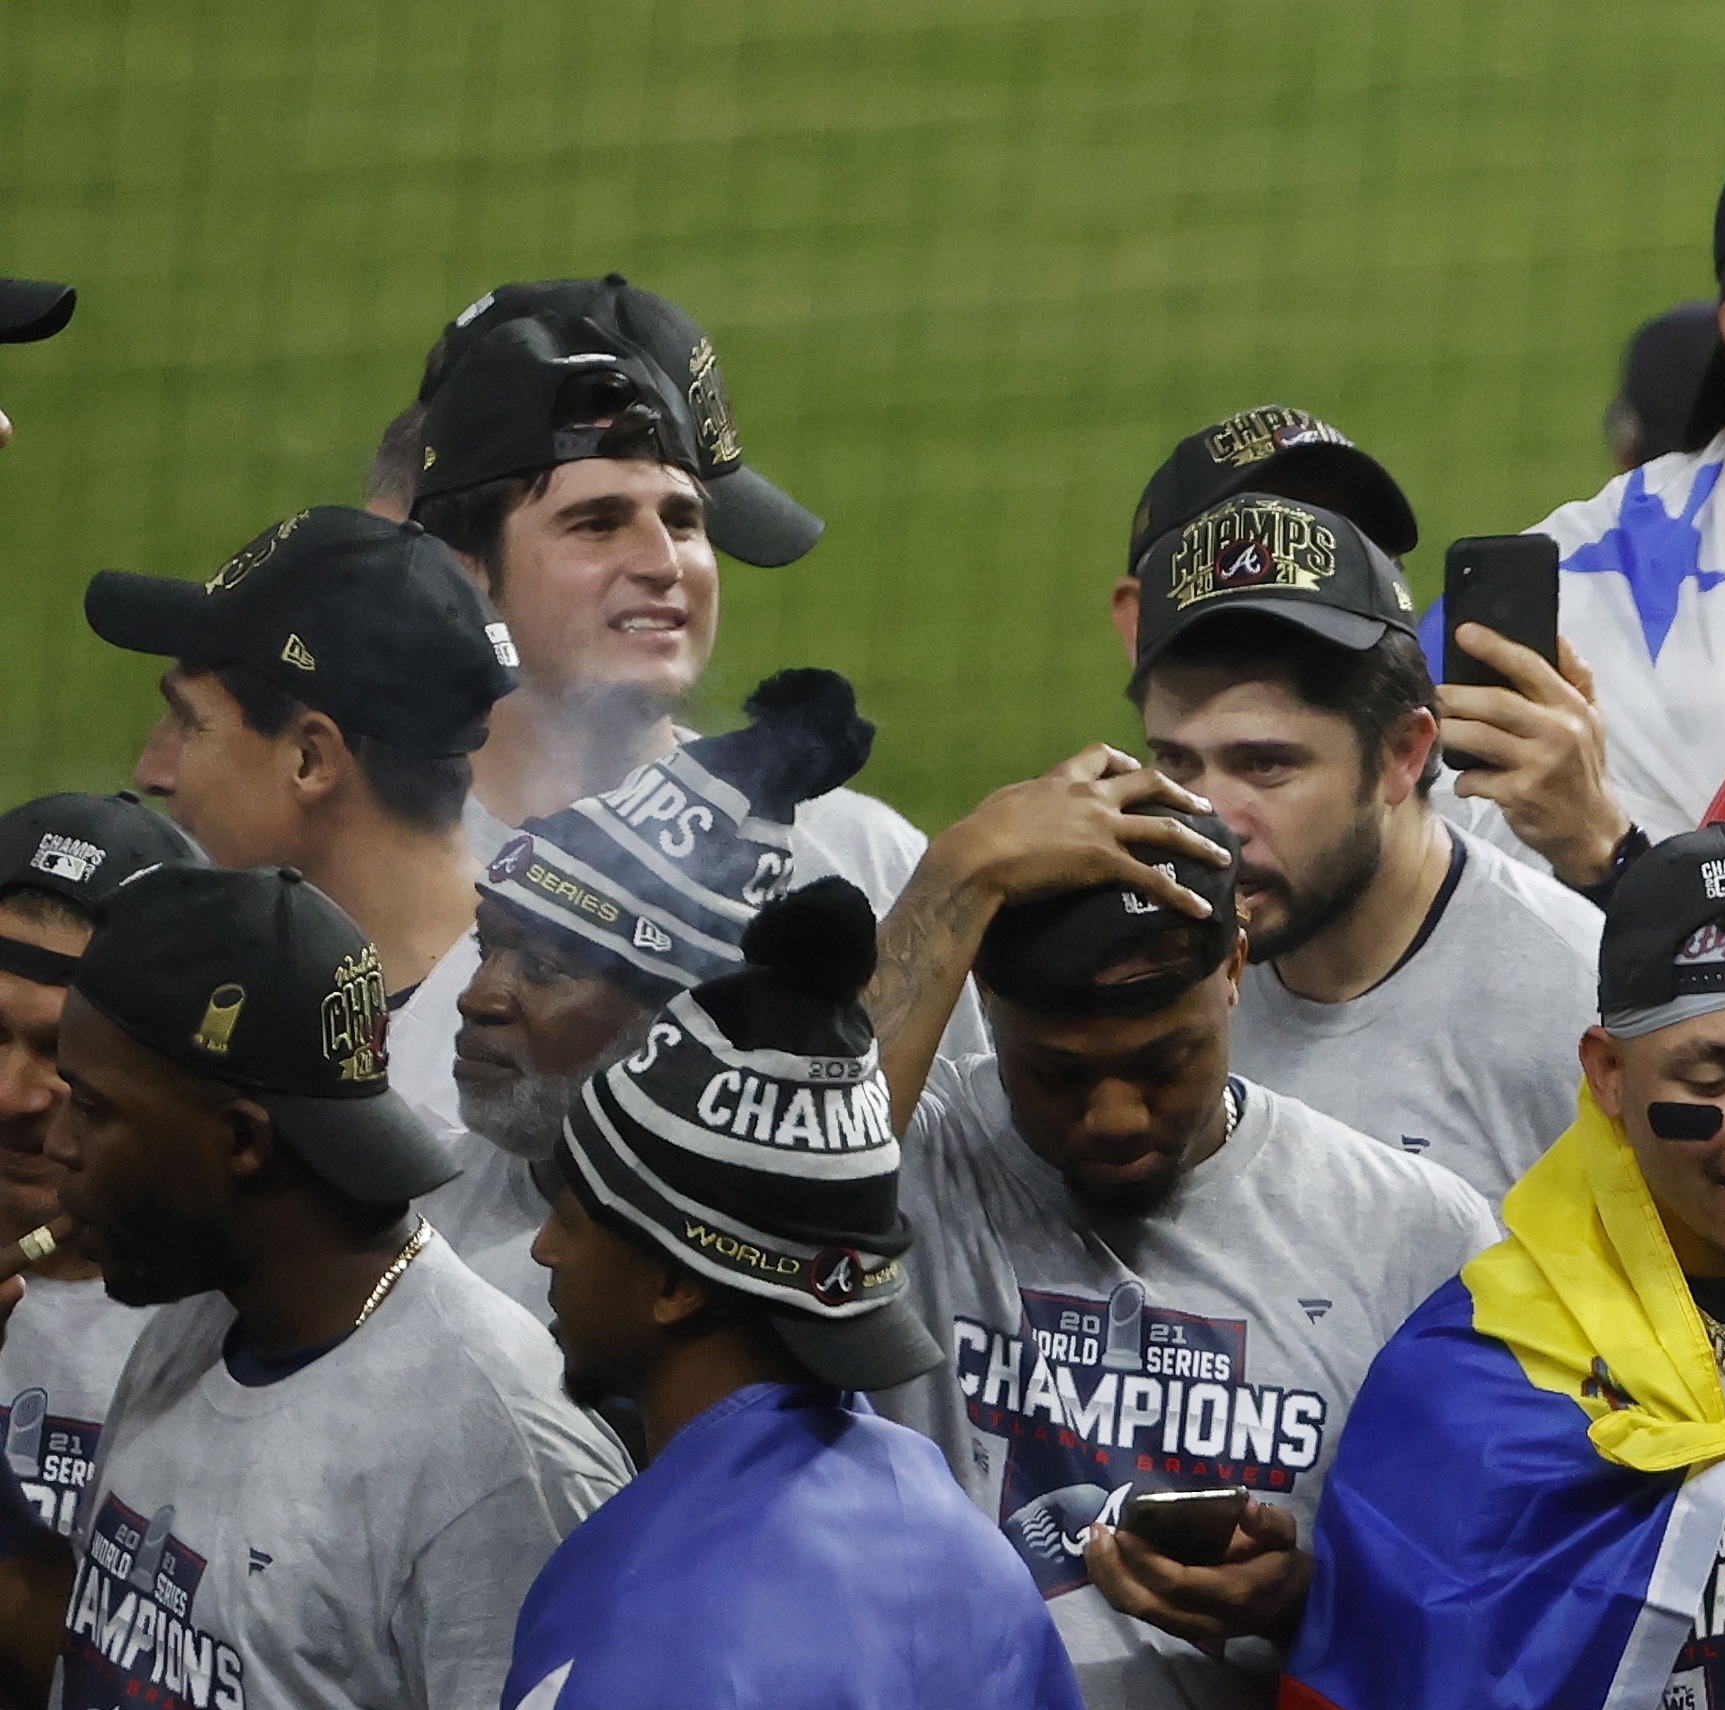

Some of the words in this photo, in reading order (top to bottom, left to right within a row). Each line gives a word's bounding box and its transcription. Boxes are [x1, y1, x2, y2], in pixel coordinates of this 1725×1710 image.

[1168, 506, 1337, 597] CHAMPS
[1221, 544, 1261, 578] A
[39, 832, 107, 867] CHAMPS
[525, 863, 619, 923] SERIES
[685, 1219, 800, 1275] WORLD
[816, 1256, 853, 1293] A
[1059, 1311, 1101, 1335] 20
[1149, 1323, 1187, 1345] 21
[1147, 1344, 1231, 1382] SERIES
[953, 1319, 1324, 1468] CHAMPIONS
[49, 1432, 83, 1456] 21
[1136, 1452, 1288, 1488] BRAVES
[91, 1529, 134, 1581] WORLD
